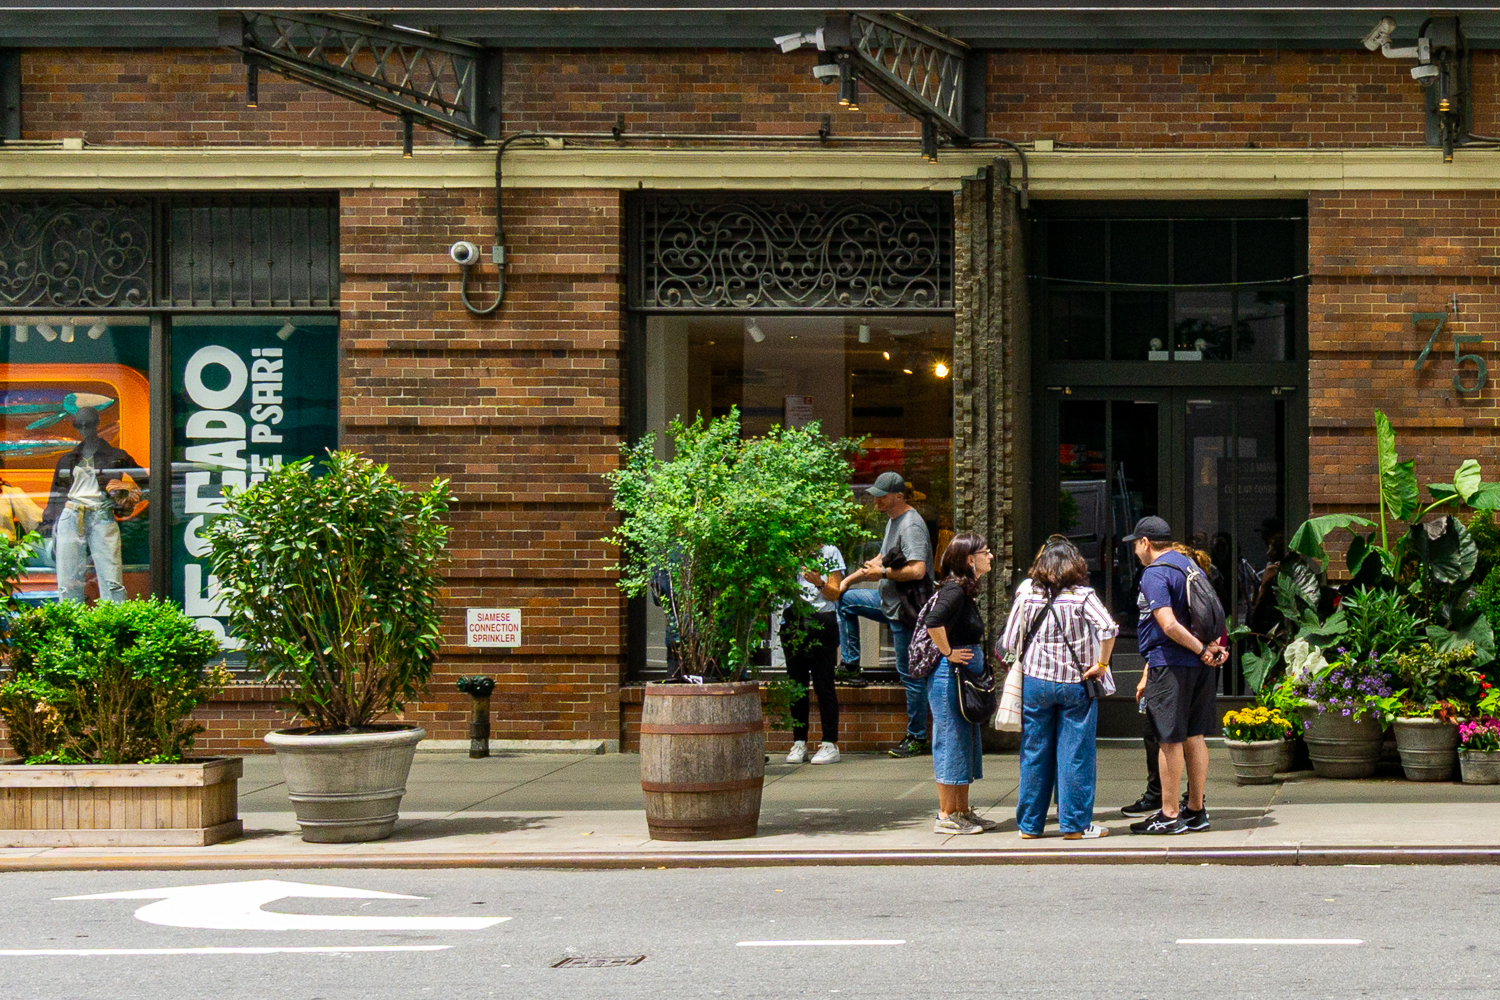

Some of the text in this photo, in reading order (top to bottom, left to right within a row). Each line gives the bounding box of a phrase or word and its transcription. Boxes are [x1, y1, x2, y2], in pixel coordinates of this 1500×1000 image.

[1412, 312, 1487, 392] 75
[477, 612, 511, 622] SIAMESE
[469, 623, 519, 632] CONNECTION
[472, 634, 516, 643] SPRINKLER
